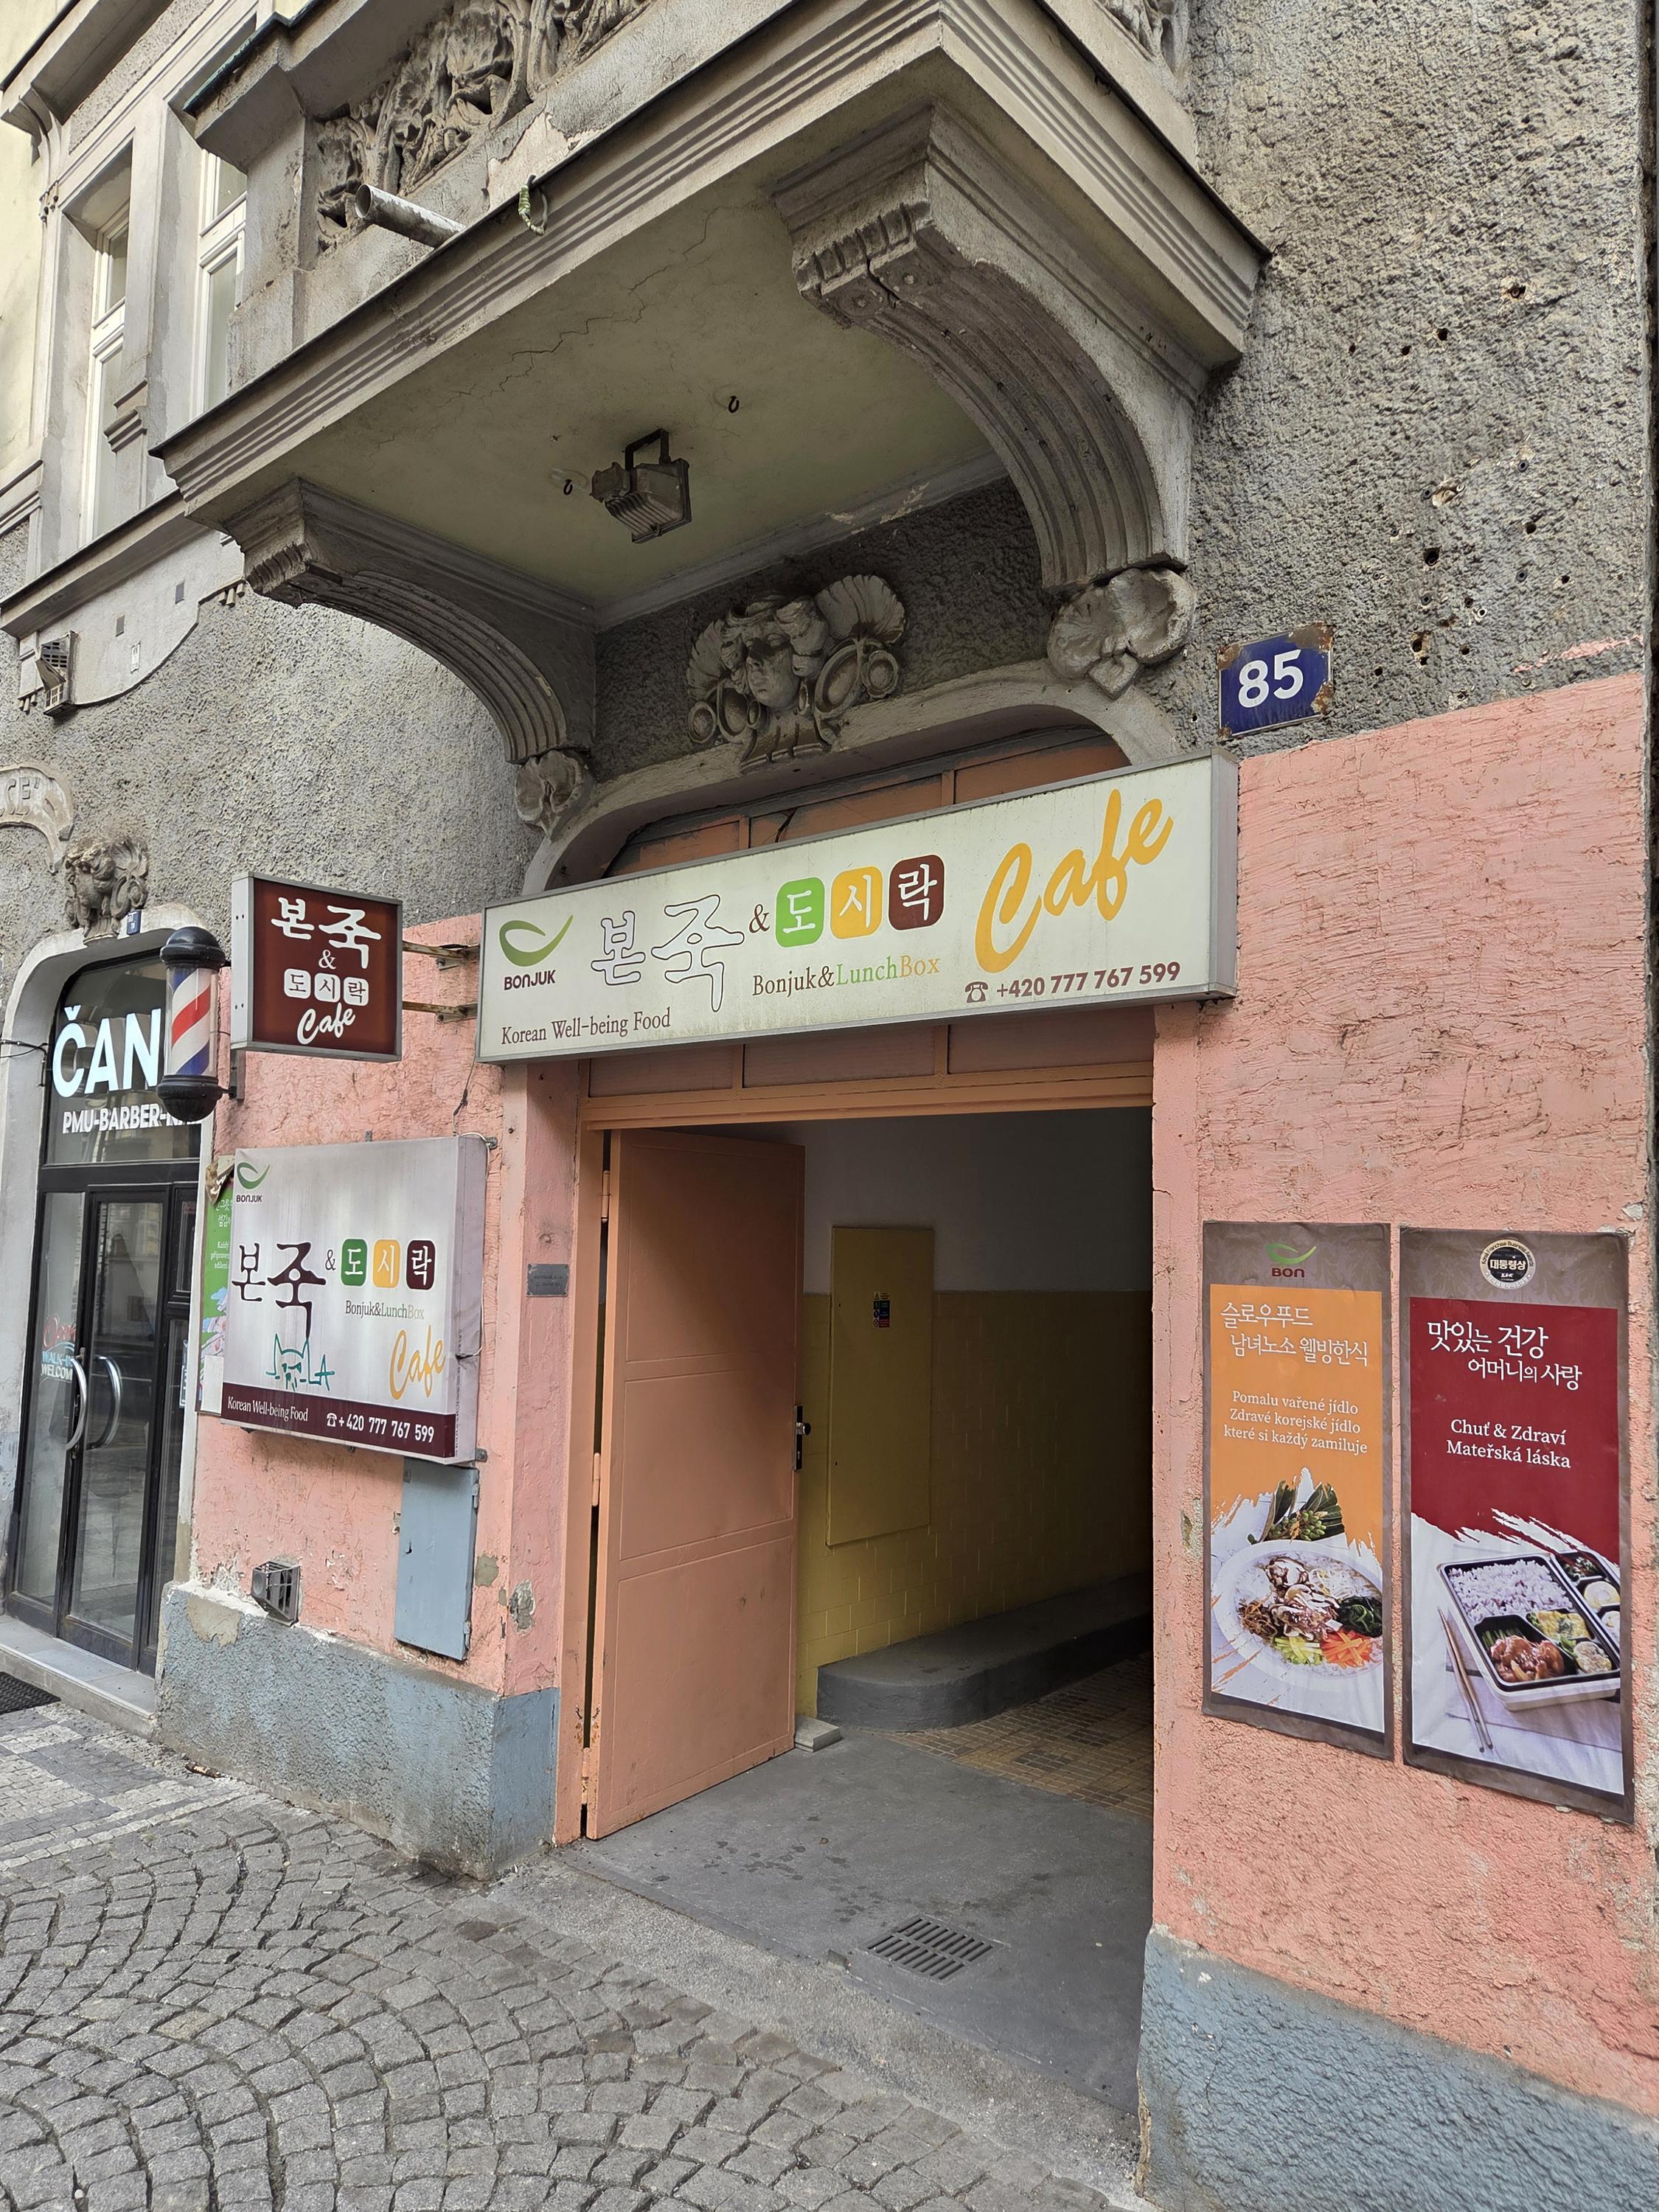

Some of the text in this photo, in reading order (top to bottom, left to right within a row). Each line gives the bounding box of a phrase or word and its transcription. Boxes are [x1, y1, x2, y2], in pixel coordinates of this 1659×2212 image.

[1238, 649, 1304, 708] 85
[975, 788, 1175, 973] Cafe
[271, 897, 382, 970] 본죽
[591, 863, 938, 1012] 본죽 & 도시락
[317, 949, 337, 970] &
[288, 975, 366, 1001] 도시락
[504, 970, 556, 990] BONJUK
[752, 955, 942, 998] Bonjuk&LunchBox
[996, 961, 1180, 998] +420 777 767 599
[297, 1003, 355, 1045] Cafe
[501, 1006, 671, 1044] Korean Well-being Food
[236, 1194, 263, 1203] BONJUK
[1271, 1267, 1305, 1279] BON
[1489, 1259, 1526, 1270] 대통령상
[231, 1241, 434, 1340] 본죽 & 도시락
[345, 1300, 425, 1321] Bonjuk&LunchBox
[1220, 1301, 1313, 1329] 슬로우푸드
[1231, 1333, 1297, 1357] 남녀노소
[1427, 1320, 1549, 1360] 맛있는 건강
[389, 1324, 446, 1401] Cafe
[1467, 1357, 1583, 1391] 어머니의 사랑
[227, 1396, 309, 1422] Korean Well-being Food
[1232, 1390, 1358, 1416] Pomalu vařené jídlo
[368, 1416, 387, 1435] 777
[391, 1419, 411, 1439] 767
[414, 1422, 435, 1444] 599
[1230, 1408, 1361, 1434] Zdravé korejské jídlo
[1451, 1419, 1567, 1445] Chuť & Zdraví
[1224, 1425, 1368, 1457] které si každý zamiluje
[1447, 1440, 1571, 1469] Mateřská láska
